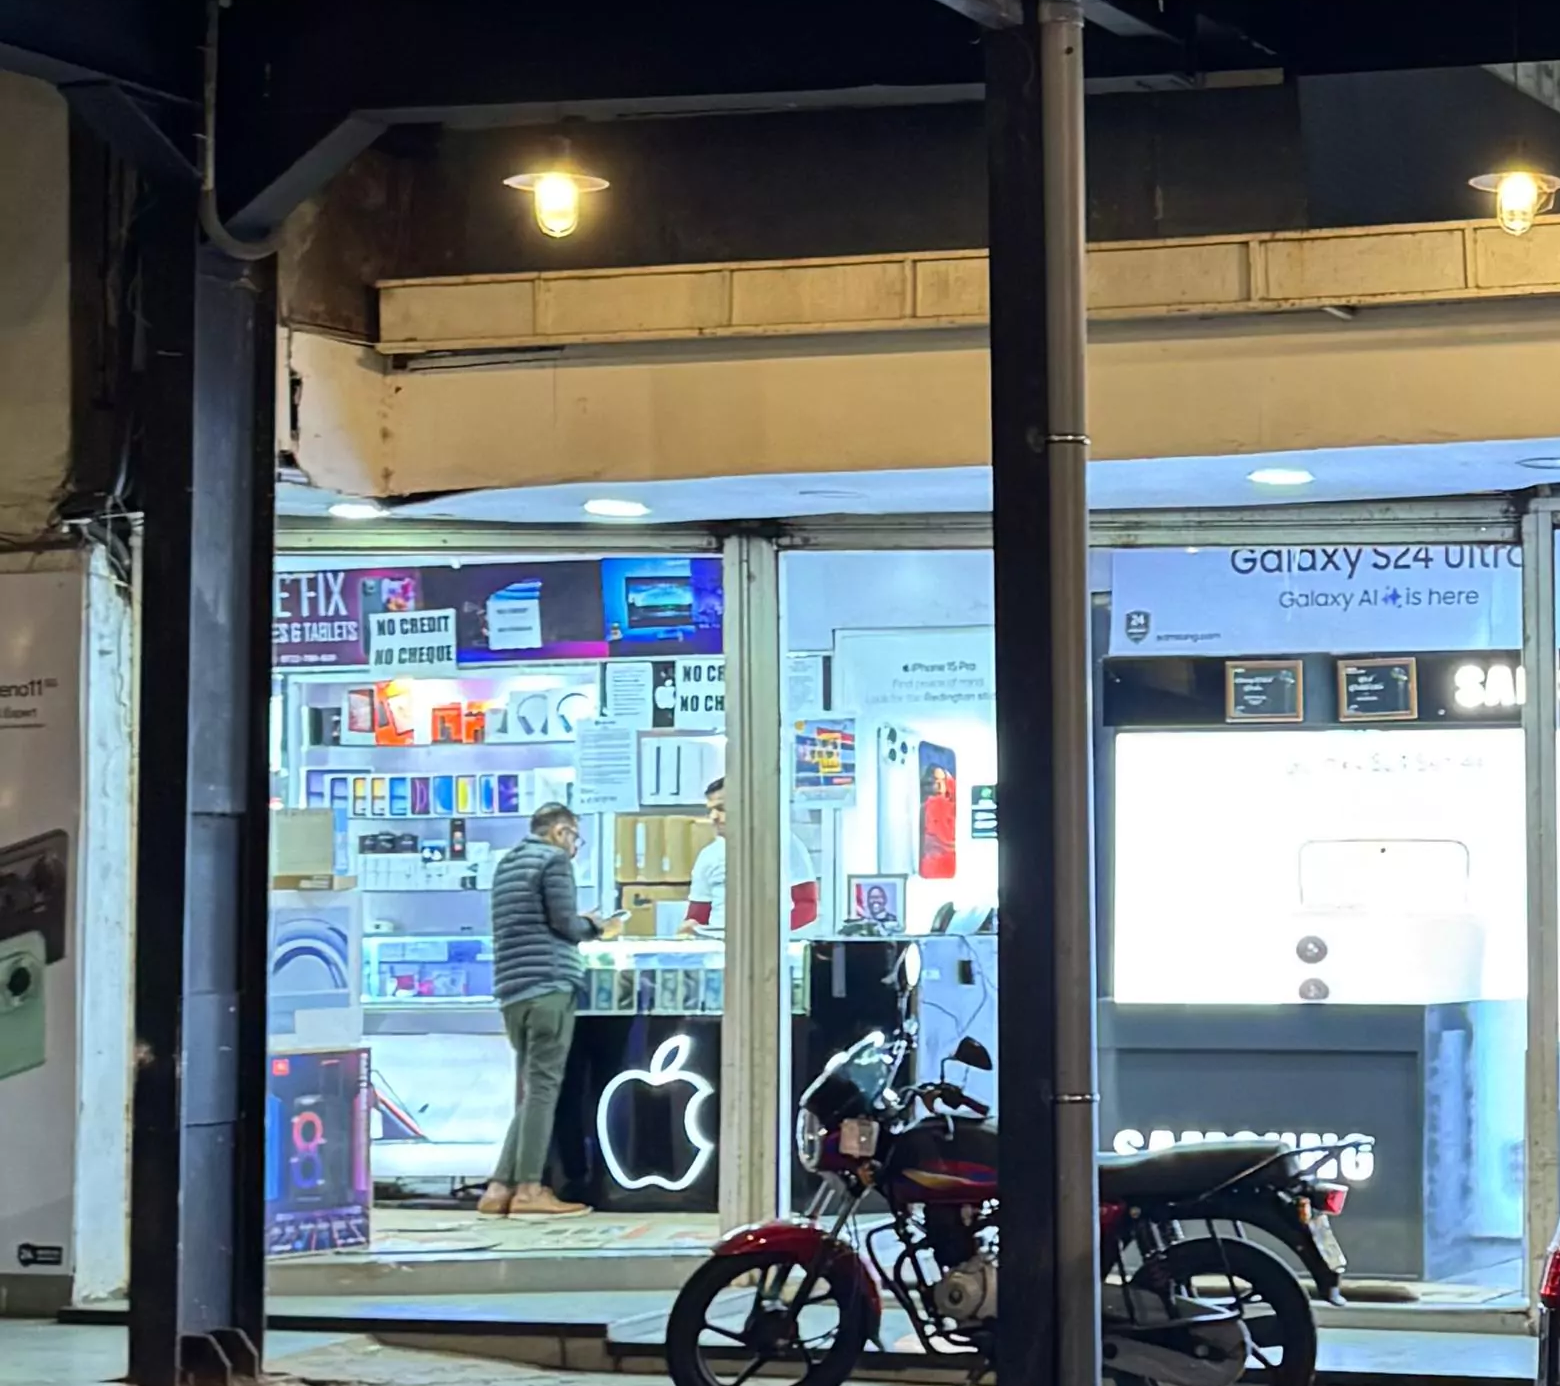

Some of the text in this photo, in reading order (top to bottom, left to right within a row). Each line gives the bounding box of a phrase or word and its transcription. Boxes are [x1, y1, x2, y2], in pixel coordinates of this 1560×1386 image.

[300, 571, 348, 618] FIX
[1278, 588, 1480, 611] Galaxy AI is here
[304, 621, 359, 643] TABLETS
[376, 615, 450, 636] NO CREDIT
[375, 645, 453, 666] NO CHEQUE
[682, 665, 702, 682] NO
[911, 661, 977, 673] iPhone 15 Pro
[680, 695, 700, 712] NO
